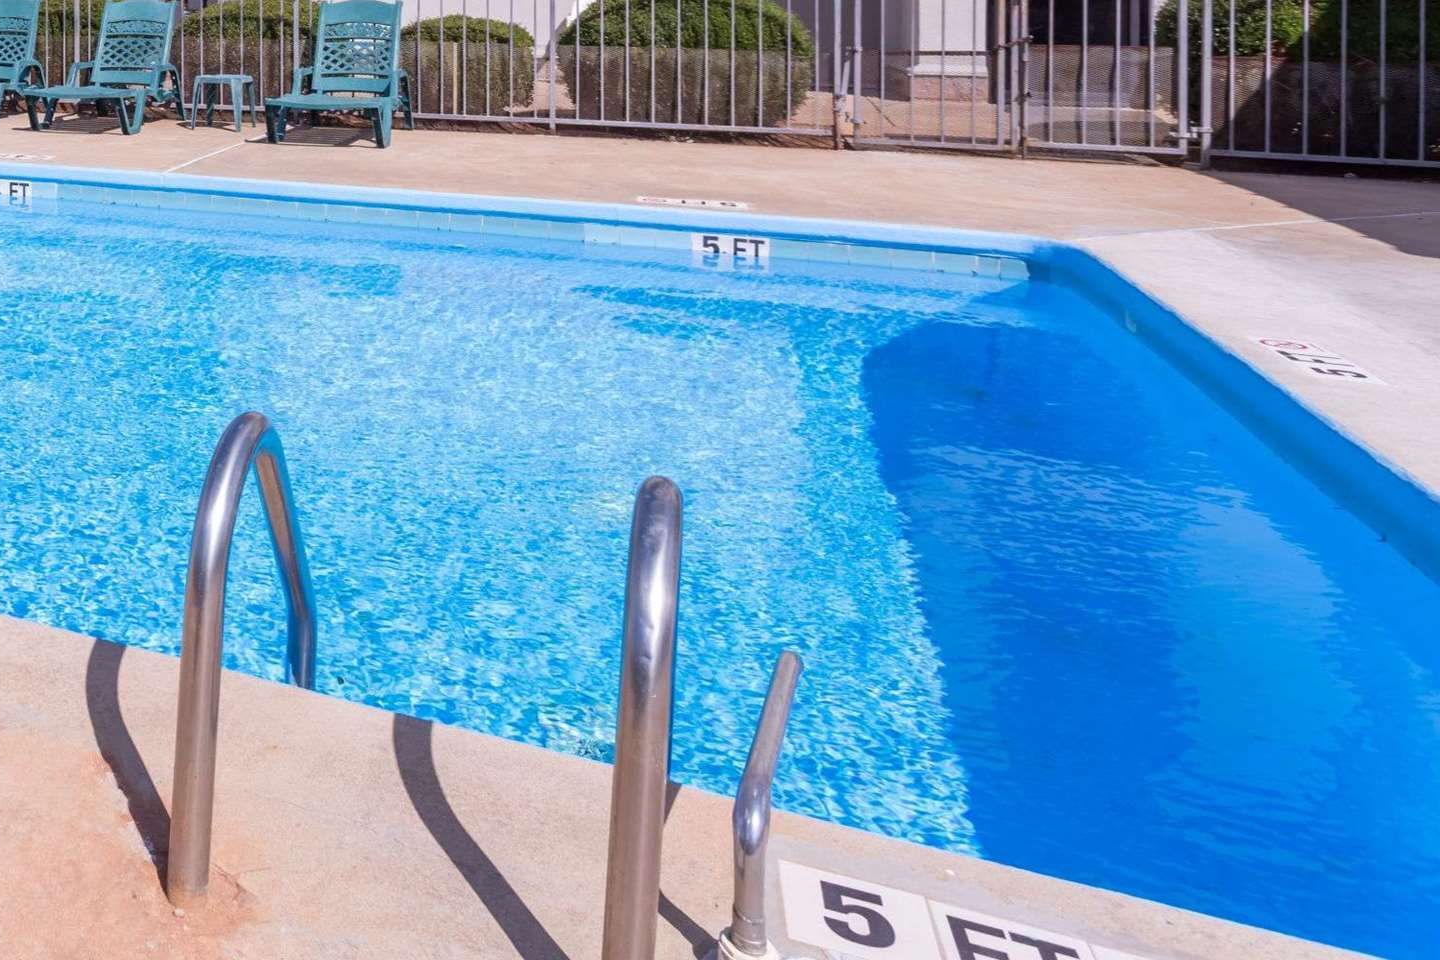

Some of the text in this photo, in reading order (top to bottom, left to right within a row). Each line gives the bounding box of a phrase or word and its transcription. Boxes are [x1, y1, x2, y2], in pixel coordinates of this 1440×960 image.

[9, 182, 29, 198] FT
[702, 235, 765, 258] 5 FT
[820, 880, 896, 948] 5
